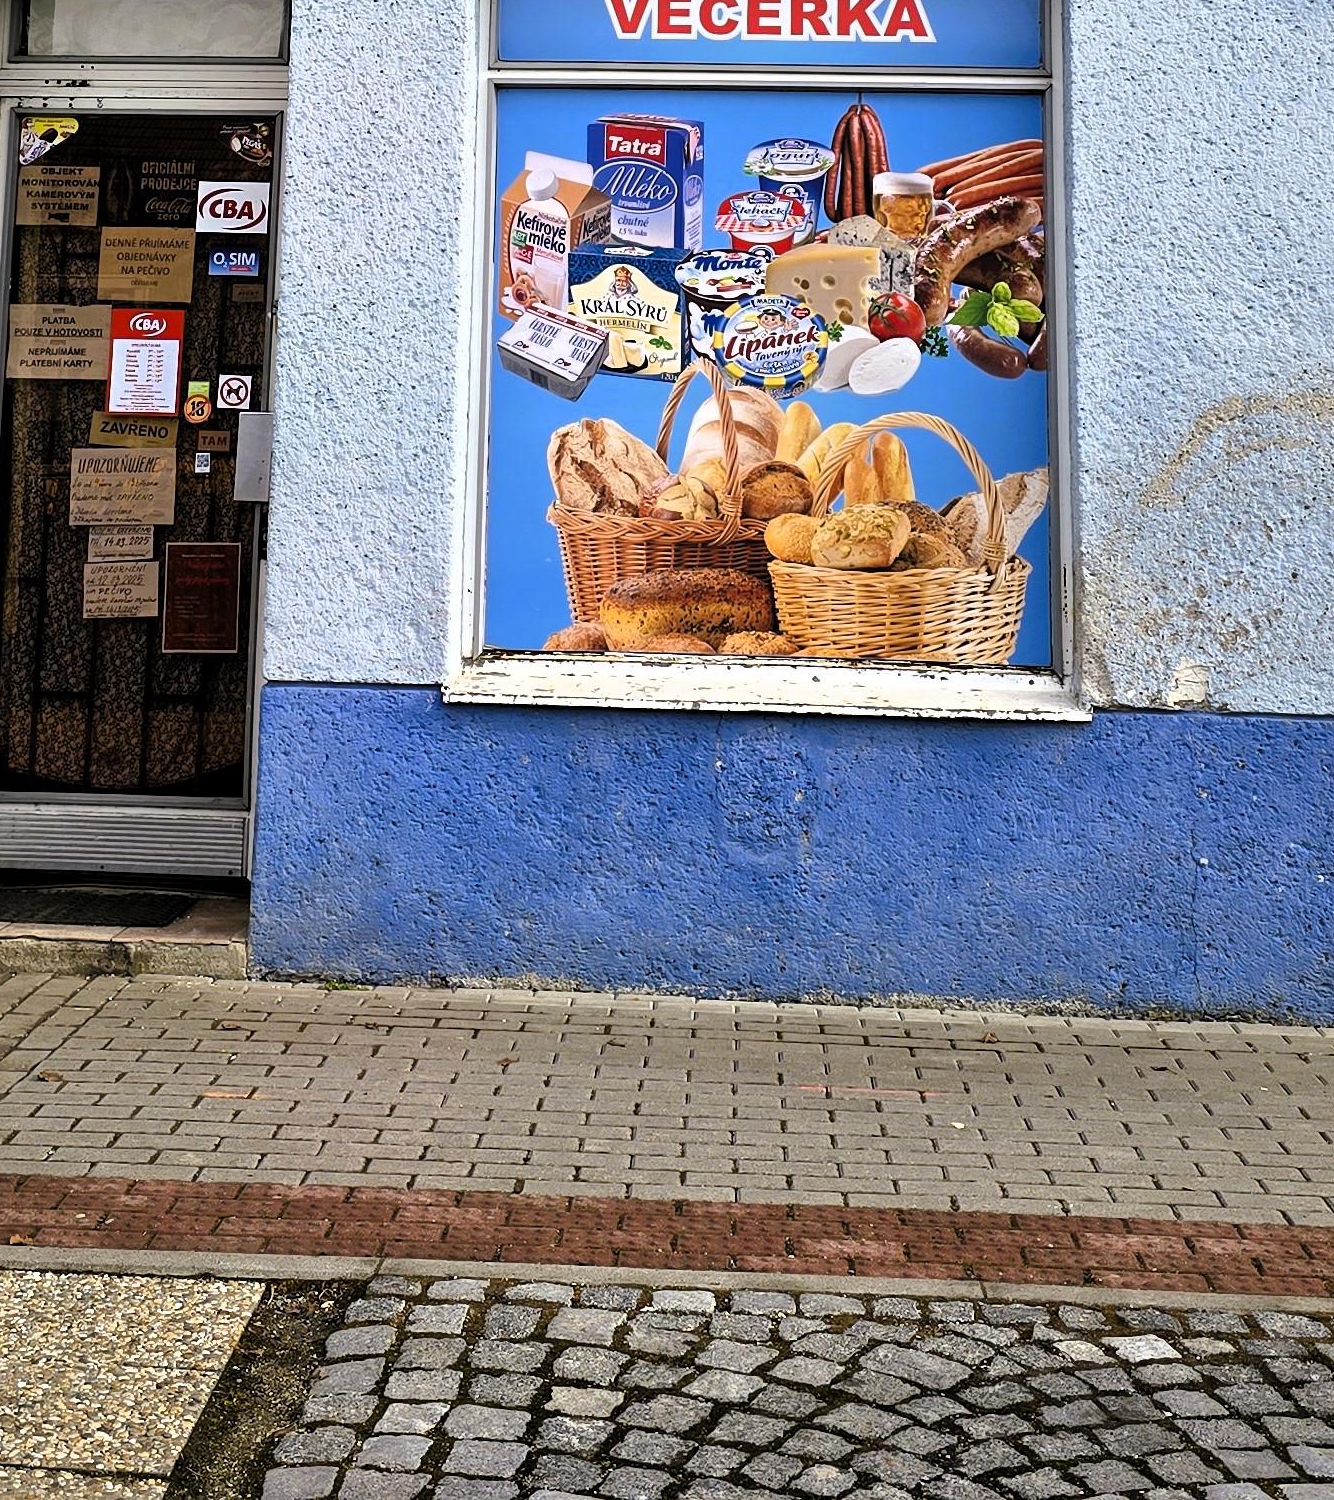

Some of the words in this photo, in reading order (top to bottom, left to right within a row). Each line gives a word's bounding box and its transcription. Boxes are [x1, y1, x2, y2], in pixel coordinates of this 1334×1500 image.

[609, 135, 662, 156] Tatra
[761, 147, 820, 161] Jogurt
[40, 167, 84, 176] OBJEKT
[141, 160, 195, 175] OFICIÁLNÍ
[21, 177, 100, 188] MONITOROVÁN
[140, 178, 197, 191] PRODEJCE
[601, 166, 674, 200] Mléko
[26, 189, 95, 199] KAMEROVÝM
[30, 200, 89, 211] SYSTÉMEM
[209, 198, 254, 220] CBA
[157, 213, 180, 221] zero
[618, 215, 650, 228] chutné
[517, 211, 567, 240] Kefírové
[105, 237, 137, 248] DENNĚ
[139, 237, 190, 249] PŘIJÍMÁME
[529, 232, 566, 255] mléko
[117, 251, 177, 263] OBJEDNÁVKY
[229, 252, 255, 266] SIM
[692, 255, 762, 272] Monte
[121, 266, 135, 275] NA
[136, 264, 170, 276] PEČIVO
[581, 297, 624, 315] KRÁL
[626, 299, 669, 322] SÝRŮ
[42, 316, 76, 325] PLATBA
[135, 318, 160, 331] CBA
[599, 319, 648, 331] HERMELÍN
[14, 328, 44, 337] POUZE
[45, 329, 51, 337] V
[53, 328, 103, 338] HOTOVOSTI
[724, 325, 821, 362] Lipánek
[28, 346, 87, 356] NEPŘIJÍMÁME
[755, 348, 791, 361] Tavený
[19, 358, 62, 368] PLATEBNÍ
[65, 359, 93, 368] KARTY
[190, 400, 205, 417] 18
[99, 420, 169, 438] ZAVŘENO
[201, 434, 228, 446] TAM
[77, 453, 161, 474] UPOZORŇUJEME
